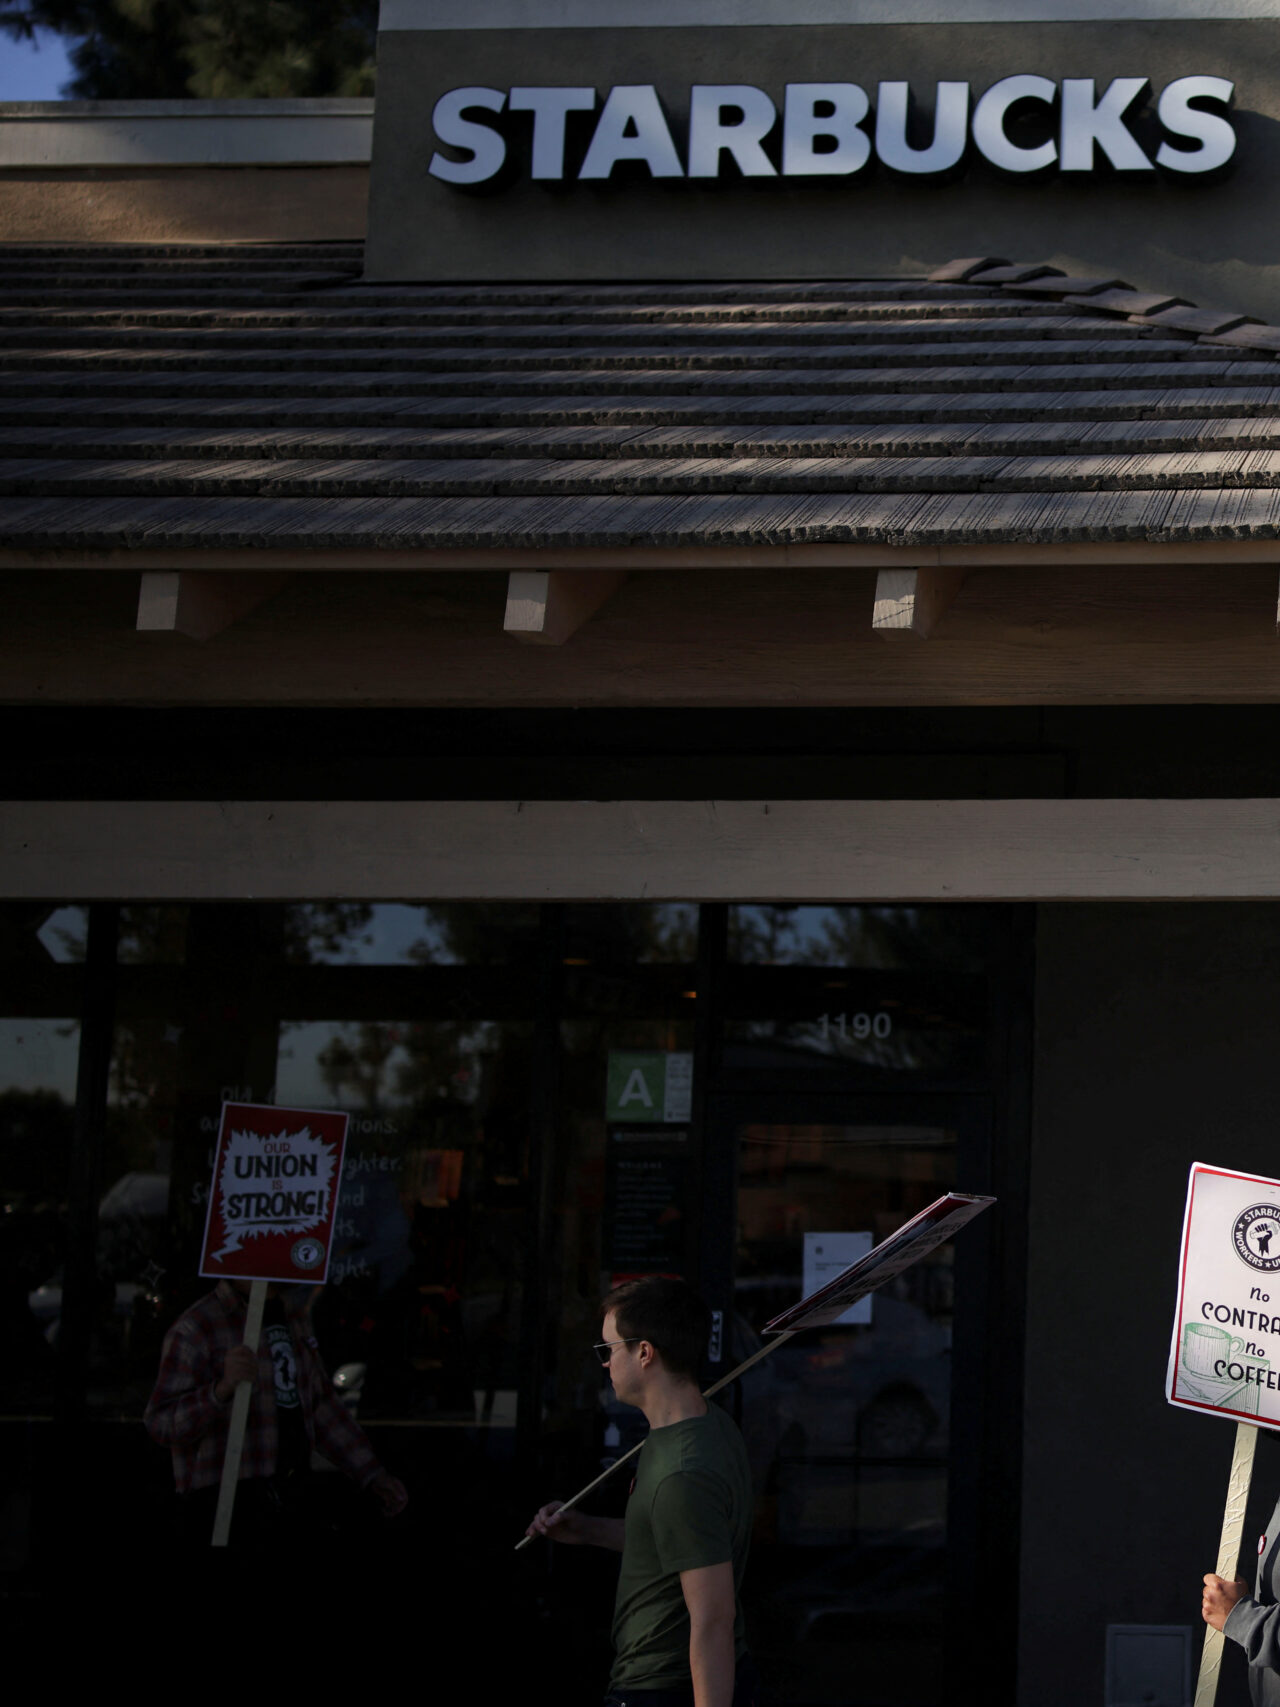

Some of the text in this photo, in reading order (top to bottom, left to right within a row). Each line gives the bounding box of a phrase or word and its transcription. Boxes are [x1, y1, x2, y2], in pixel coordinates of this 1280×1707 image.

[426, 75, 1237, 184] STARBUCKS
[816, 1011, 892, 1039] 1190
[617, 1068, 655, 1108] A
[264, 1143, 290, 1154] OUR
[234, 1154, 317, 1178] UNION
[272, 1180, 282, 1190] IS
[227, 1190, 324, 1219] STRONG!
[1235, 1231, 1263, 1267] WORKERS
[1245, 1342, 1265, 1357] no
